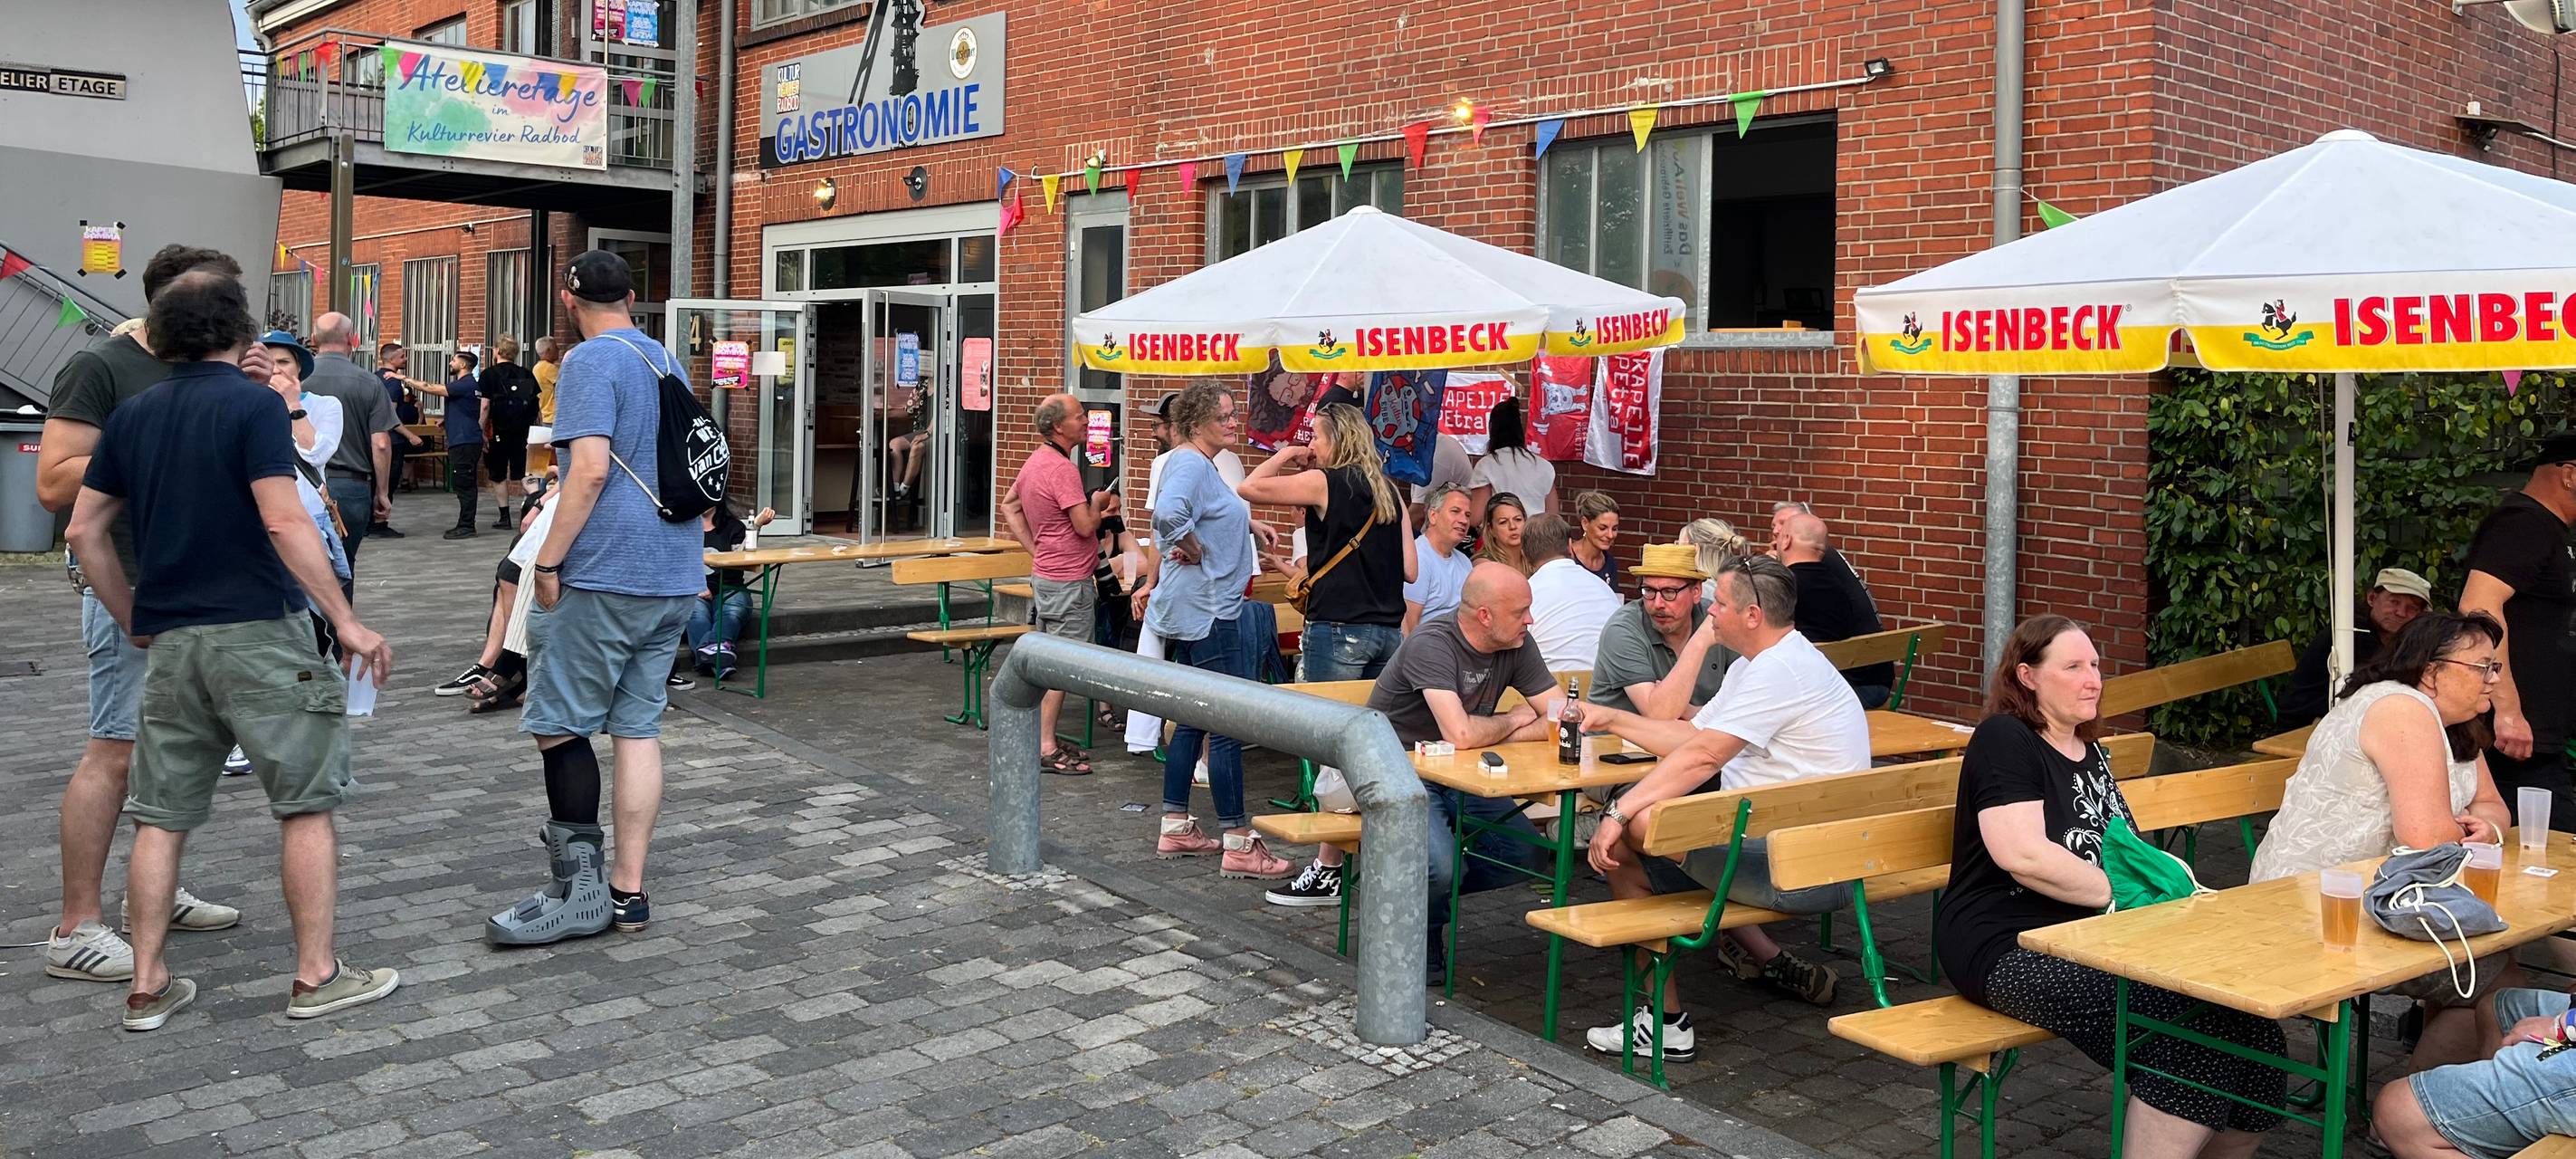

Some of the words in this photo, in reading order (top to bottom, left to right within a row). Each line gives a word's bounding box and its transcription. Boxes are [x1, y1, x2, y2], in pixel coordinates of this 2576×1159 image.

[0, 72, 47, 89] ELIER
[58, 77, 117, 95] ETAGE
[778, 64, 799, 82] KULTUR
[492, 104, 508, 115] im
[777, 94, 799, 113] RADBOD
[407, 120, 515, 143] Kulturrevier
[520, 125, 580, 144] Radbod
[776, 83, 980, 160] GASTRONOMIE
[1356, 322, 1509, 356] ISENBECK
[1596, 308, 1668, 344] ISENBECK
[1942, 305, 2123, 351] ISENBECK
[1130, 333, 1239, 361] ISENBECK
